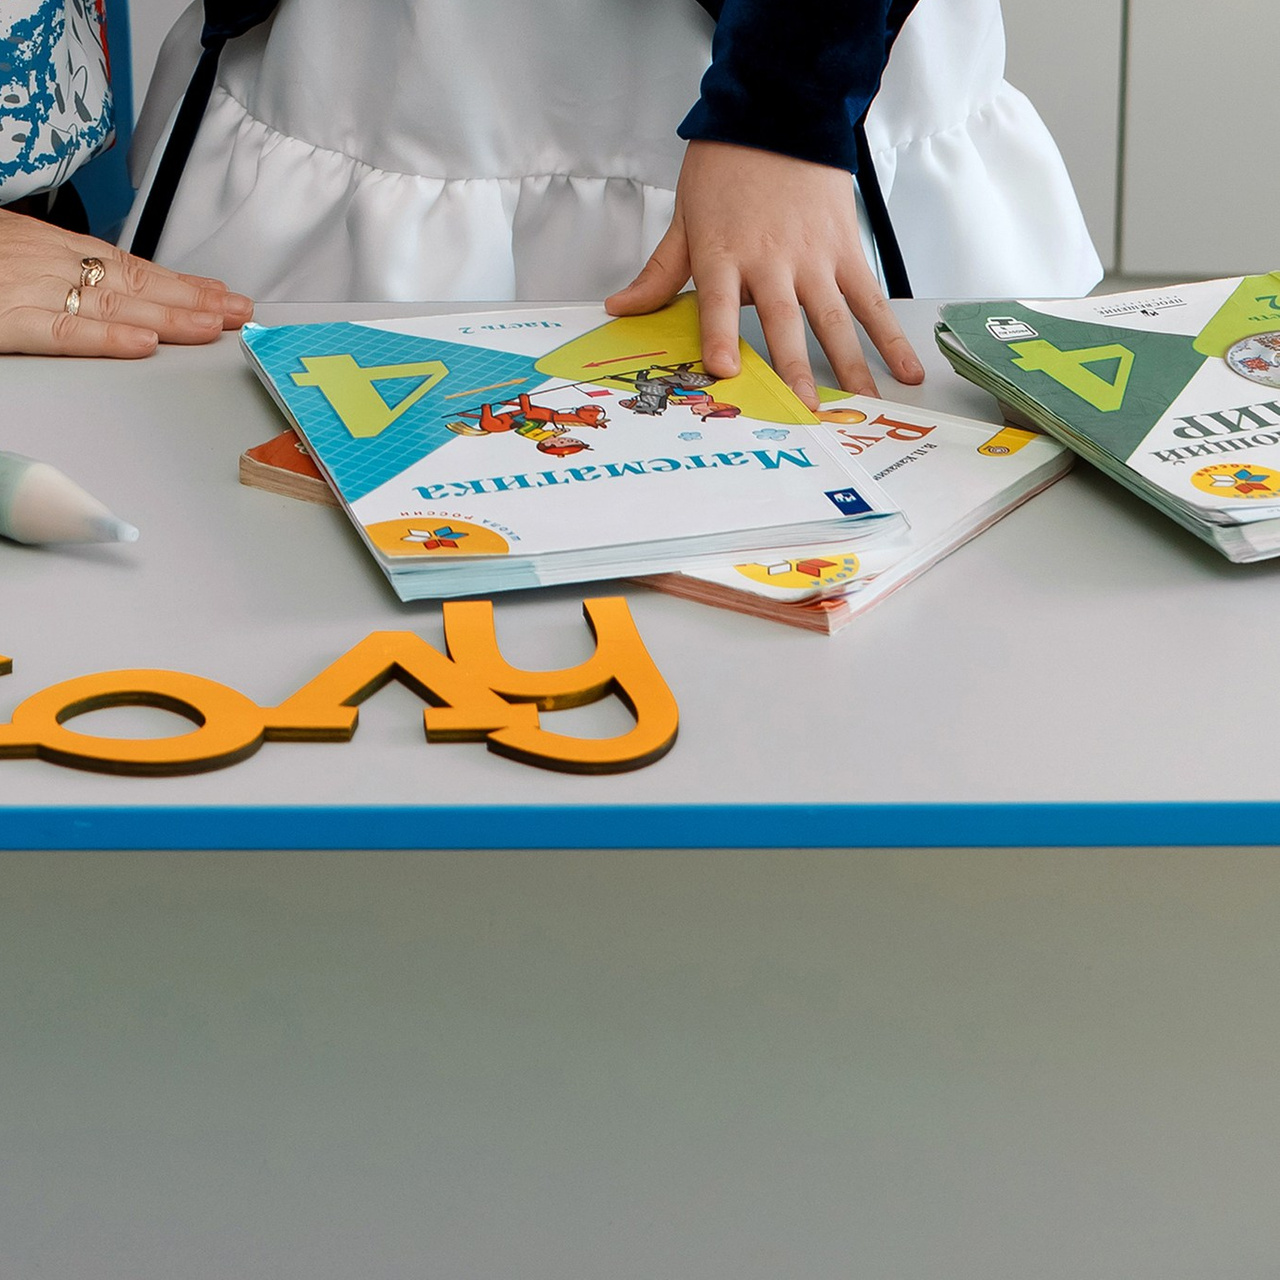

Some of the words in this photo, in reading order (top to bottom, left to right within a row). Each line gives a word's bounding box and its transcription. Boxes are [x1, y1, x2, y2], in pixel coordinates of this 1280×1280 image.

[458, 326, 475, 335] 2
[480, 320, 562, 332] Часть
[1005, 338, 1135, 413] 4
[290, 353, 449, 439] 4
[412, 445, 819, 502] Математика
[399, 510, 474, 521] РОССИИ
